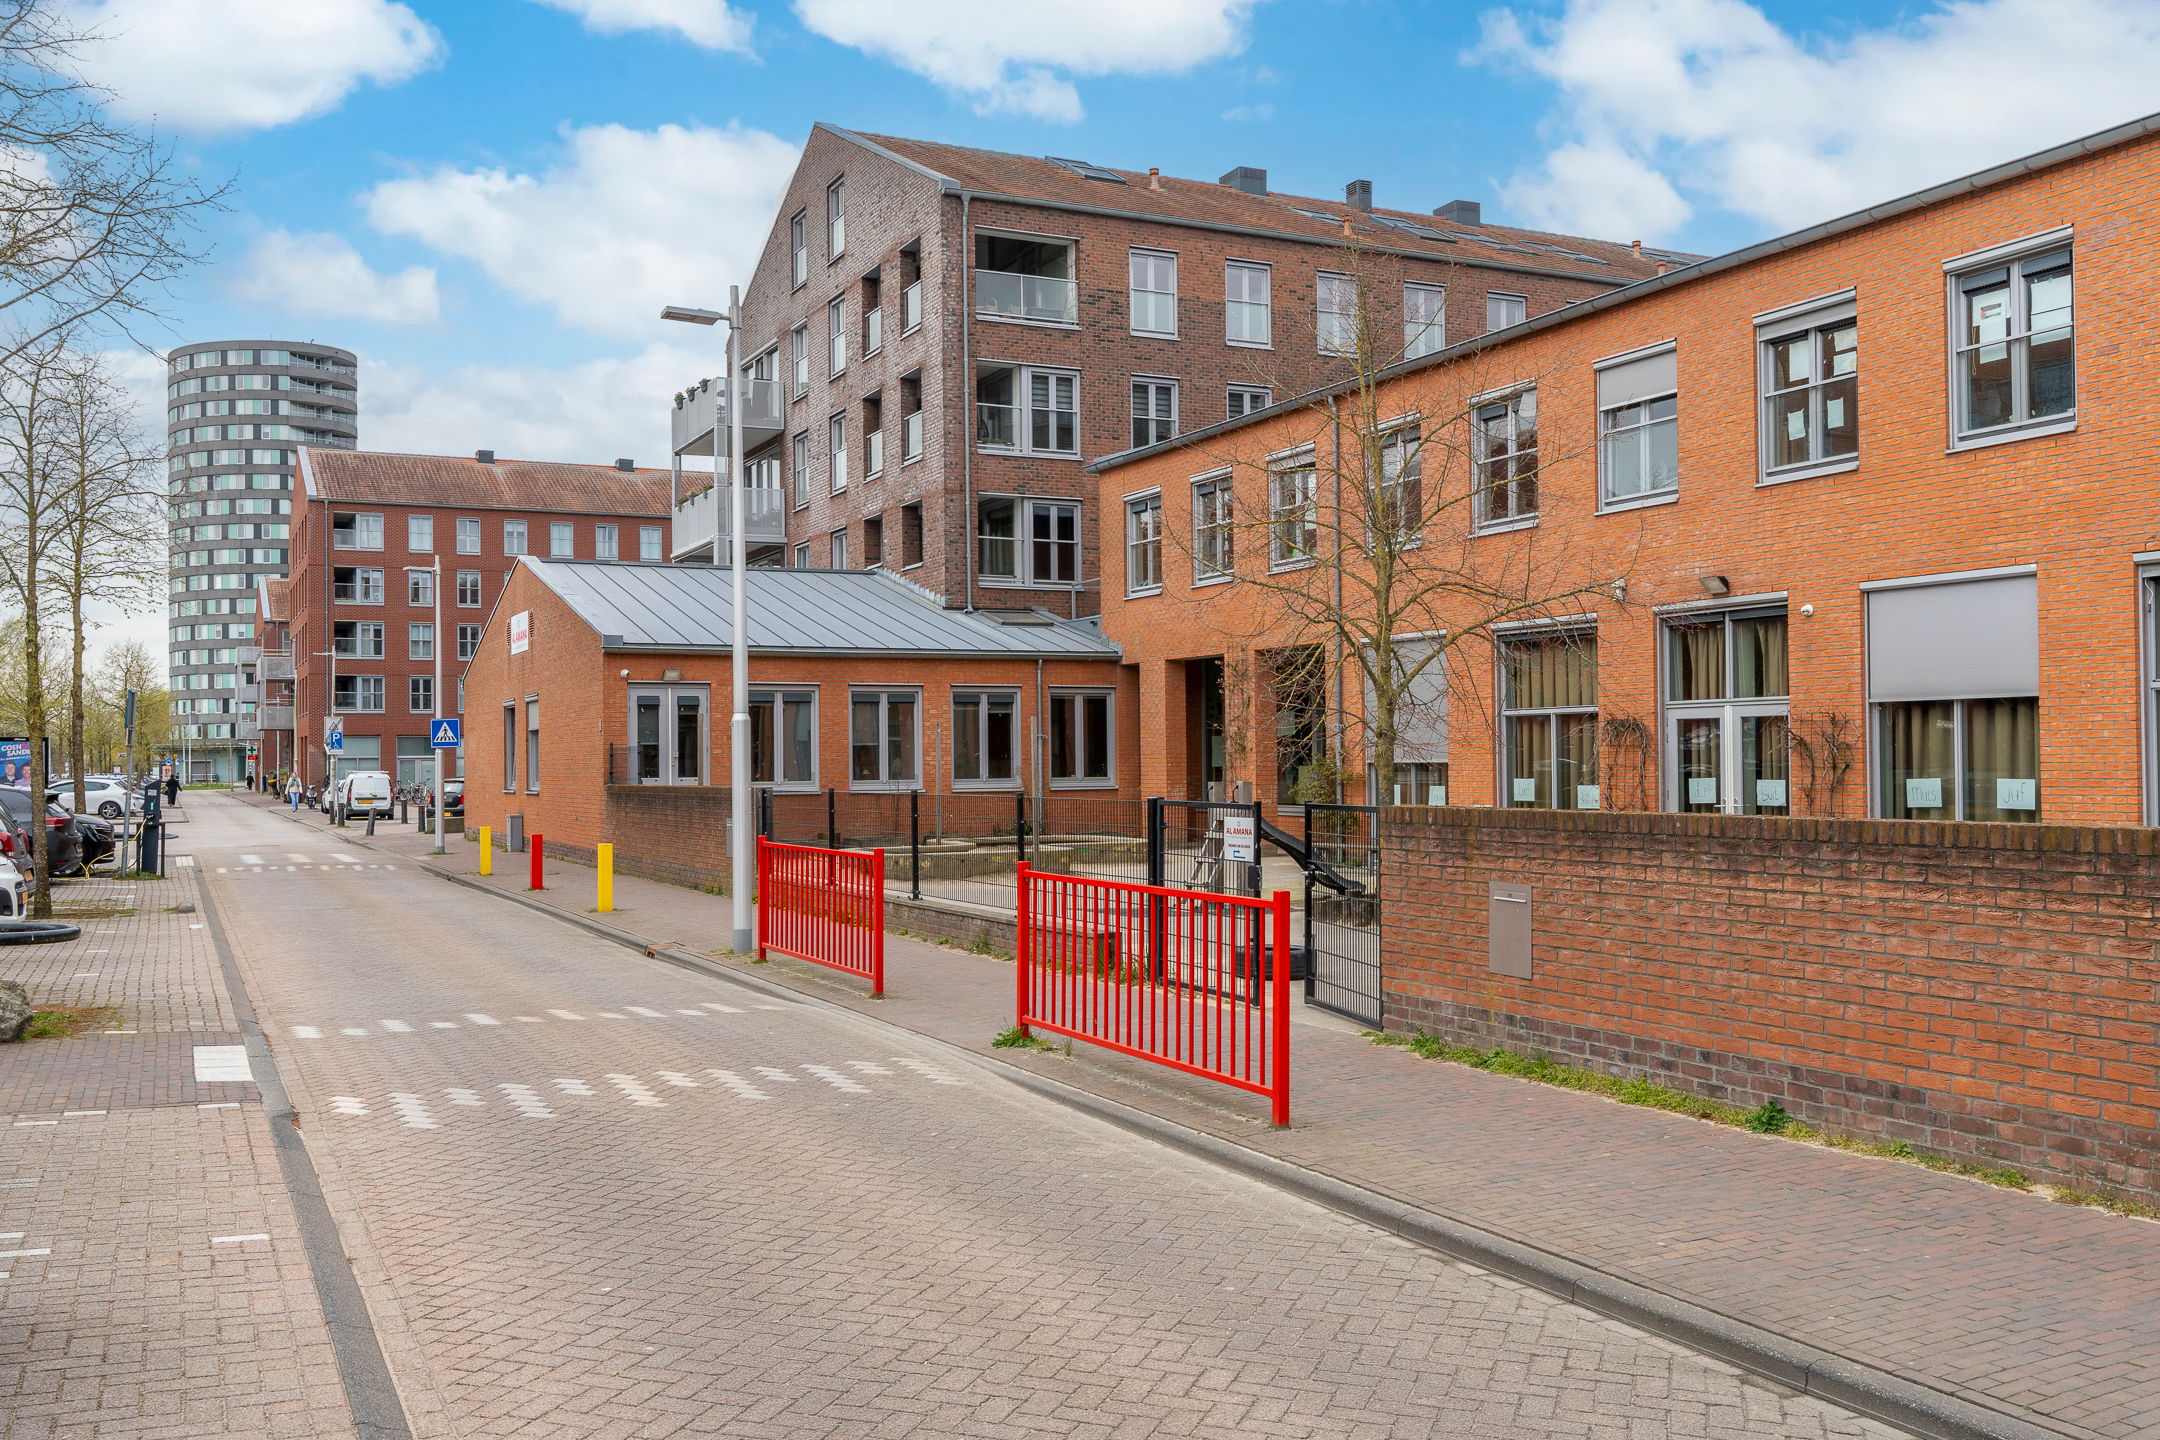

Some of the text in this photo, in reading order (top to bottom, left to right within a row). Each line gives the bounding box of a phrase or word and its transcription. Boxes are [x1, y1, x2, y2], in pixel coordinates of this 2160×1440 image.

[332, 733, 340, 743] P
[1, 744, 22, 752] COEN
[1233, 827, 1253, 836] AMANA
